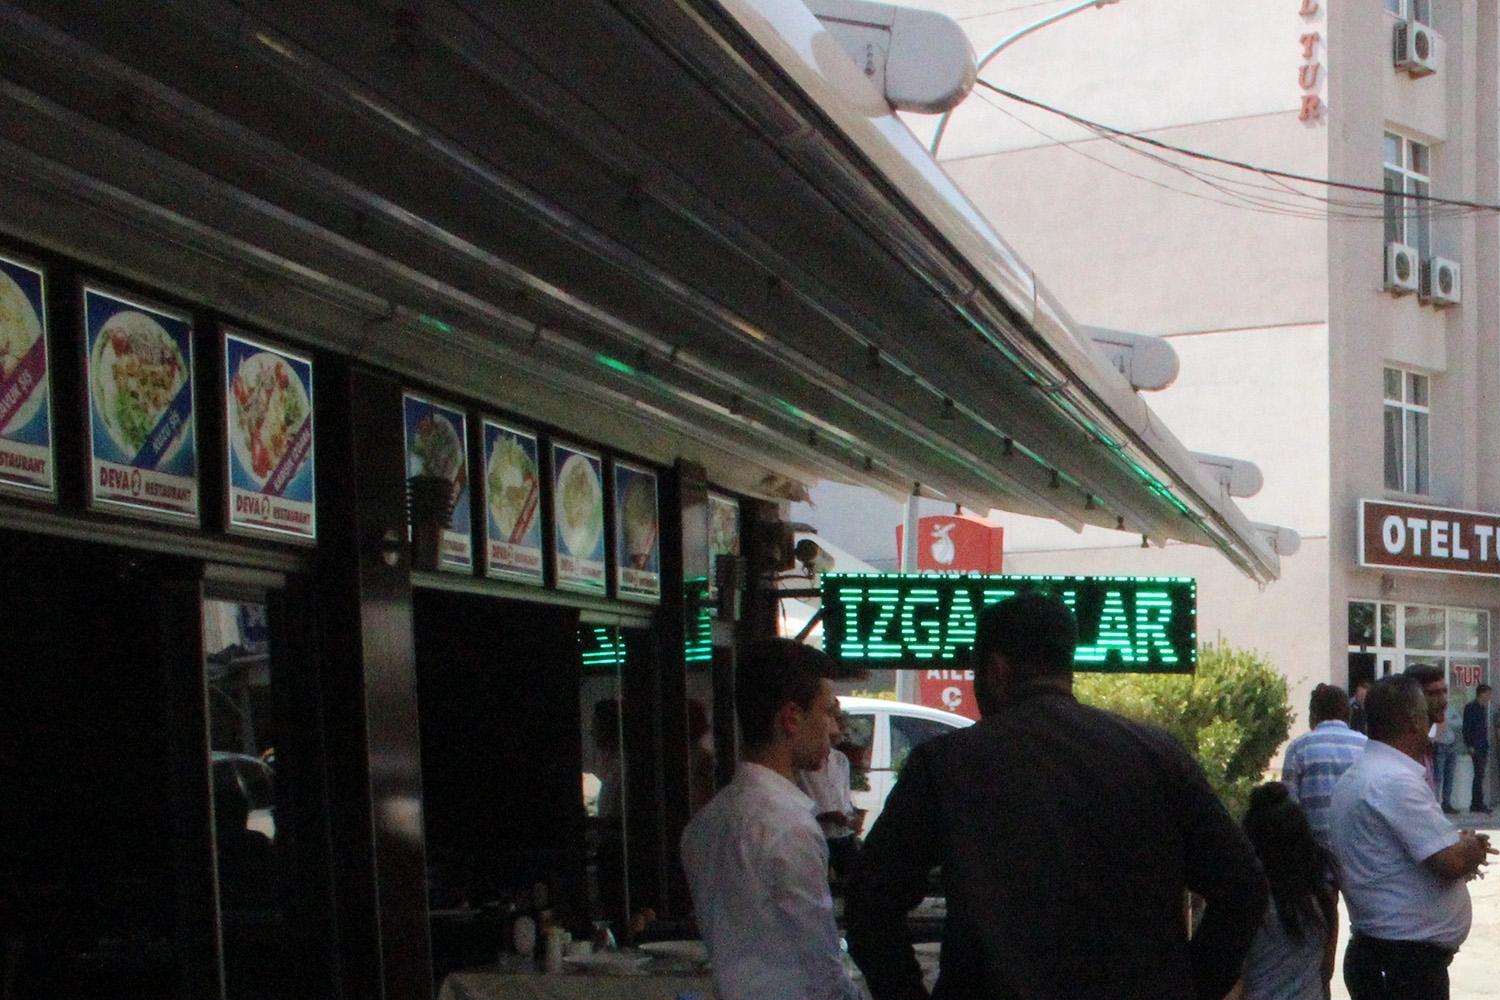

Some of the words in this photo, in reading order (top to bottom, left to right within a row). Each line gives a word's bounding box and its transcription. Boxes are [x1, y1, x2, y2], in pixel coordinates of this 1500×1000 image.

[1298, 31, 1320, 122] TUR
[0, 451, 46, 475] STAURANT
[100, 467, 130, 490] DEVA
[145, 481, 192, 501] RESTAURANT
[236, 494, 261, 516] DEVA
[1382, 513, 1470, 561] OTEL
[839, 588, 1179, 663] IZGALAR
[1454, 665, 1482, 688] TUR
